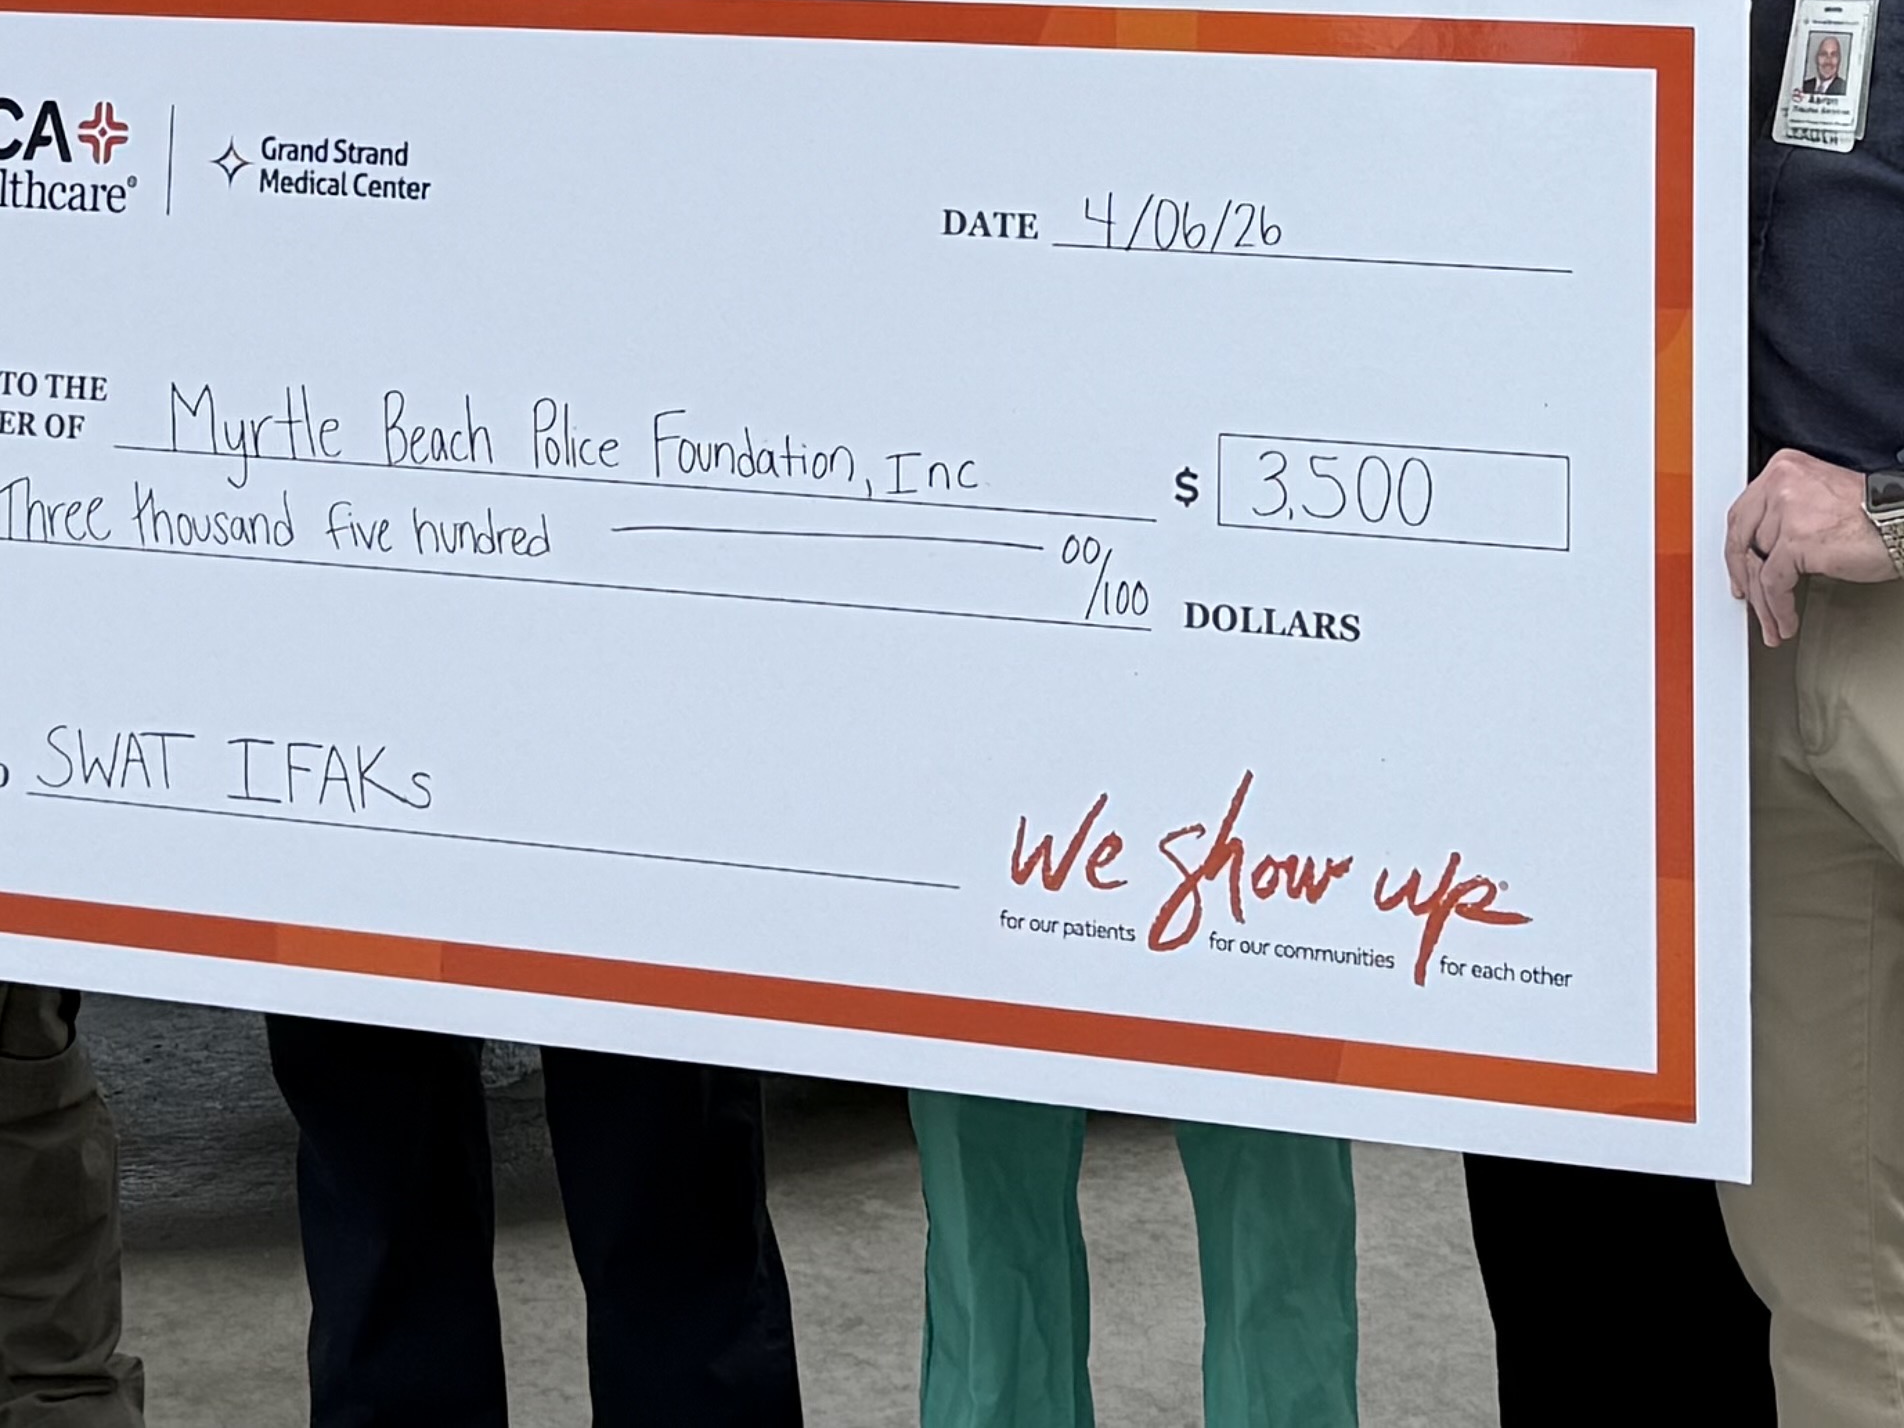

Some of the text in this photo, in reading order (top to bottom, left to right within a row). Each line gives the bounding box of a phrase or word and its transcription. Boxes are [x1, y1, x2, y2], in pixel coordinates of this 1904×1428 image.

[261, 136, 409, 166] Grand Strand
[259, 169, 431, 201] Medical Center
[941, 192, 1282, 253] DATE 4/06/26
[45, 373, 108, 402] THE
[45, 414, 86, 440] OF
[169, 381, 342, 489] Myrtle
[382, 389, 494, 466] Beach
[532, 397, 620, 470] Police
[1174, 450, 1433, 528] $ 3,500
[133, 480, 296, 547] thousand
[327, 500, 393, 553] five
[412, 507, 551, 557] hundred
[1182, 600, 1362, 642] DOLLARS
[36, 724, 196, 789] SWAT
[226, 738, 432, 813] IFAKs
[1010, 769, 1534, 987] We show up
[999, 910, 1136, 942] for our patients
[1208, 930, 1396, 970] for our communities
[1439, 955, 1574, 988] for each other
